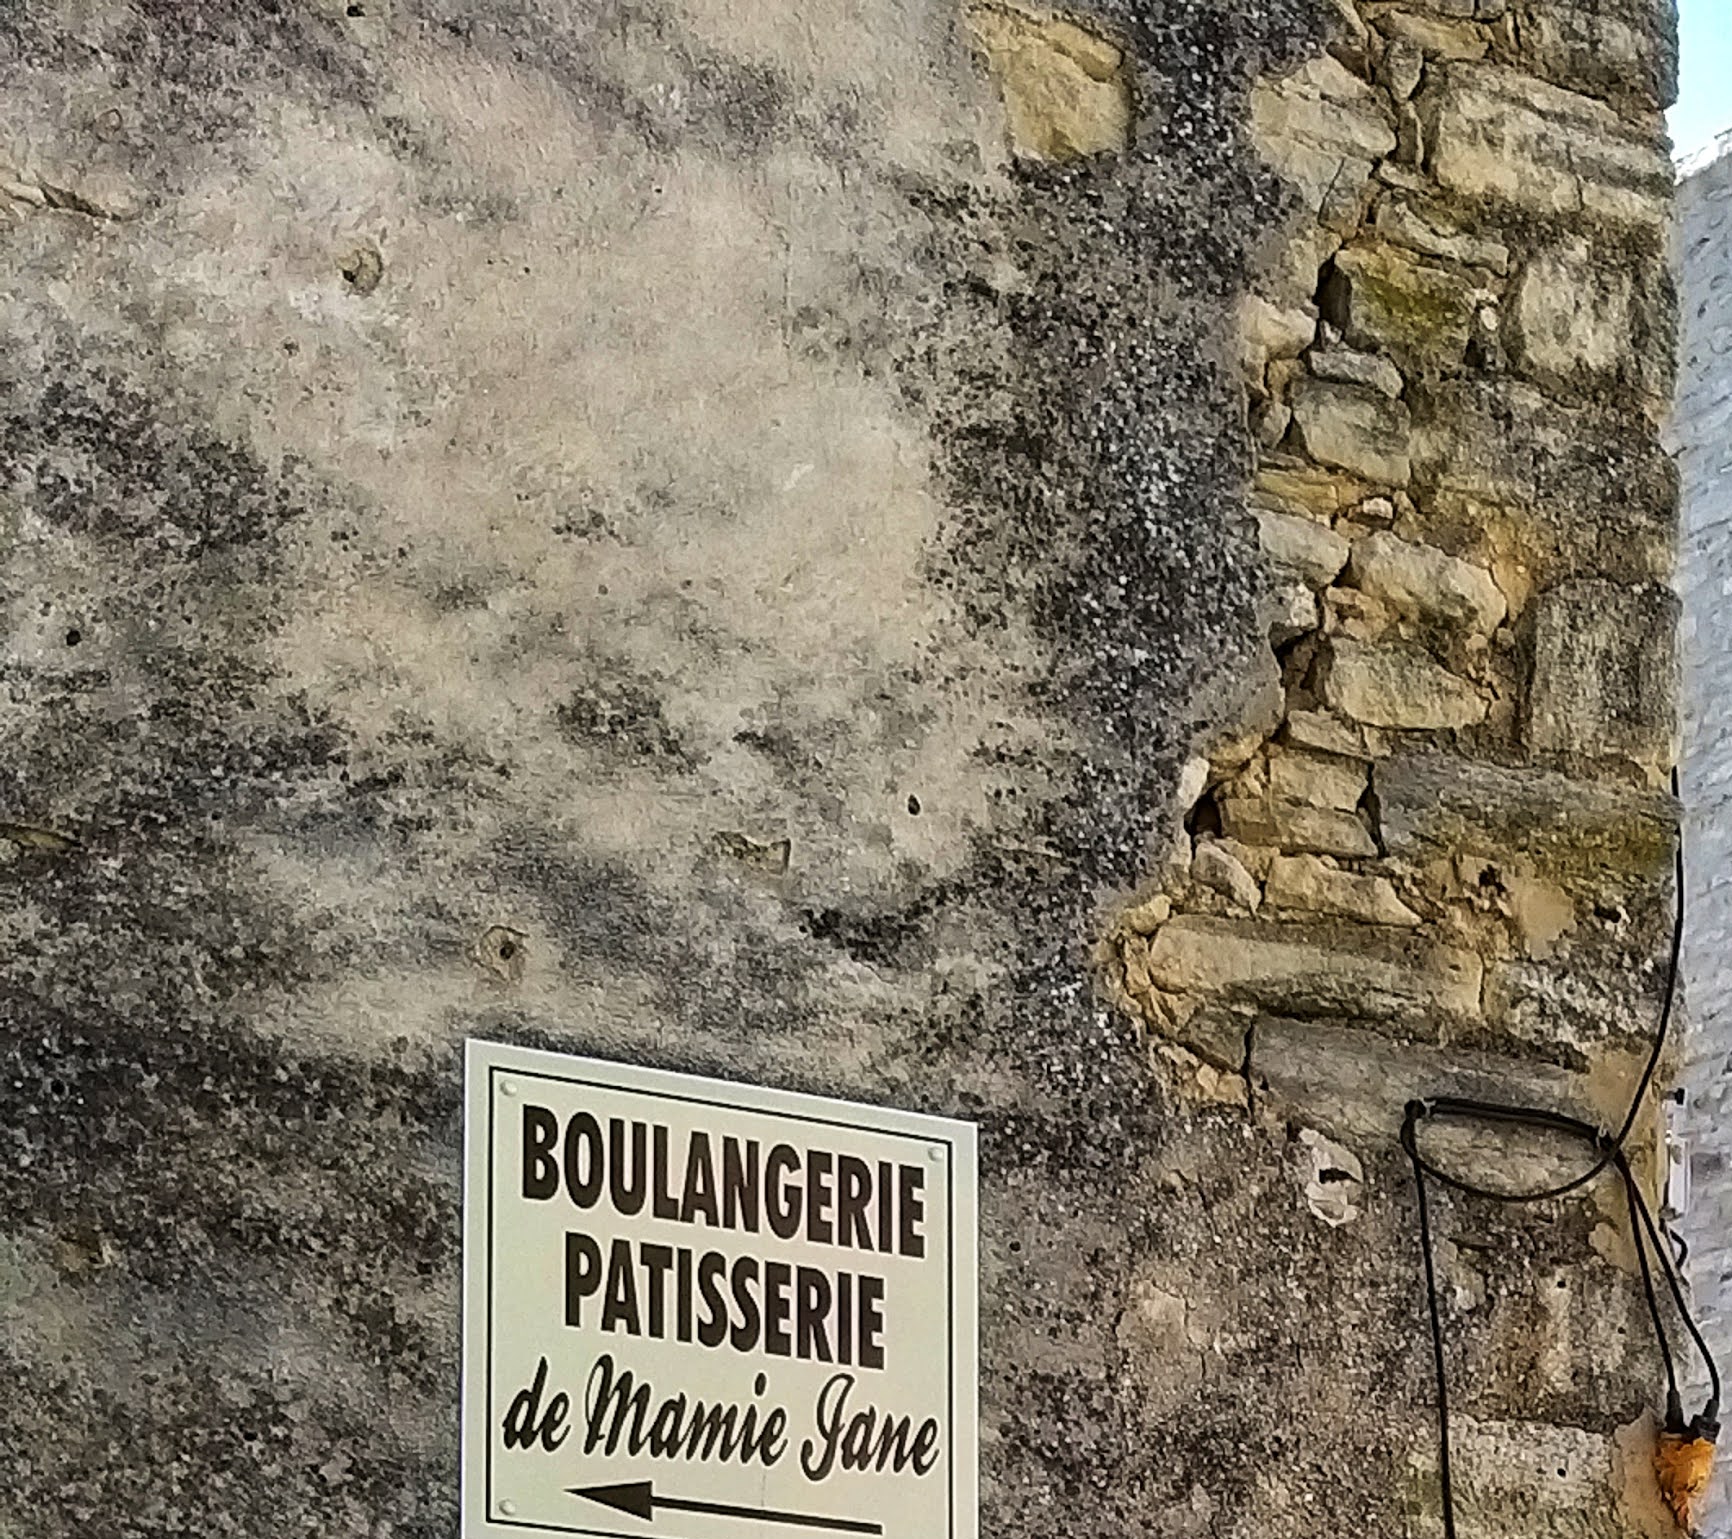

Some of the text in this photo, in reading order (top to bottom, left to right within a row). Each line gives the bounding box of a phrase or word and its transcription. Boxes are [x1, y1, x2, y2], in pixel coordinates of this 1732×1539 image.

[522, 1103, 925, 1259] BOULANGERIE
[565, 1231, 885, 1370] PATISSERIE
[502, 1354, 940, 1482] de Mamie Jane
